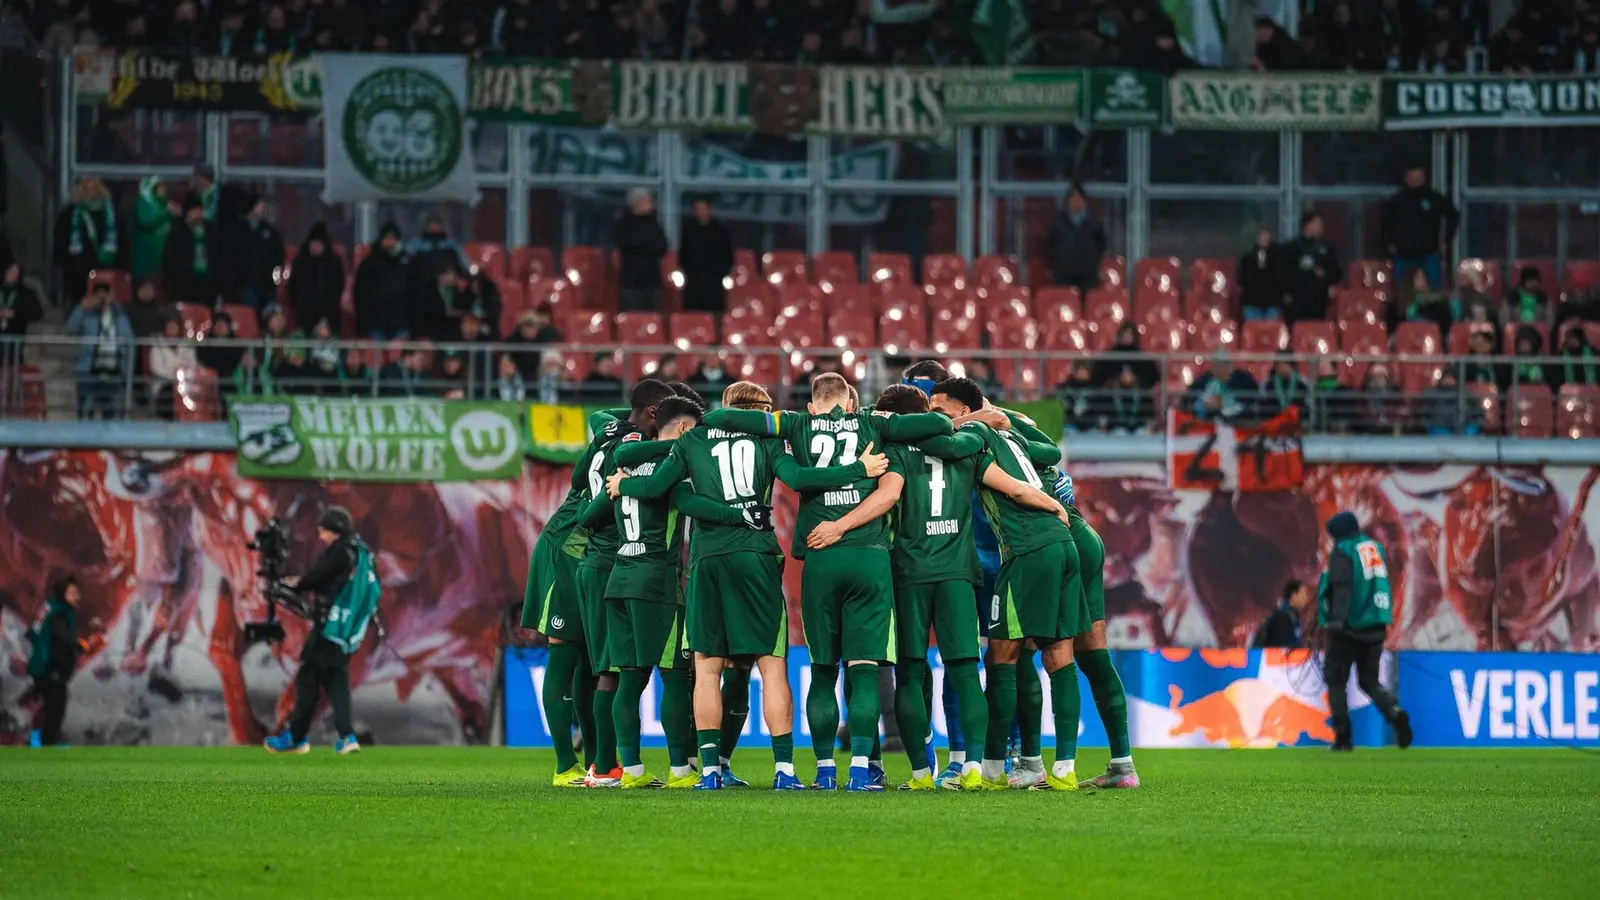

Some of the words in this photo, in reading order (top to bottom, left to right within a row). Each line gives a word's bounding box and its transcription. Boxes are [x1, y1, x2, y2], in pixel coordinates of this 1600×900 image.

[818, 66, 945, 136] HERS
[299, 404, 447, 434] MEILEN
[711, 439, 756, 501] 10
[824, 489, 861, 506] ARNOLD
[923, 454, 946, 517] 7
[925, 520, 960, 535] SHIOGAI
[1449, 669, 1600, 740] VERLE
